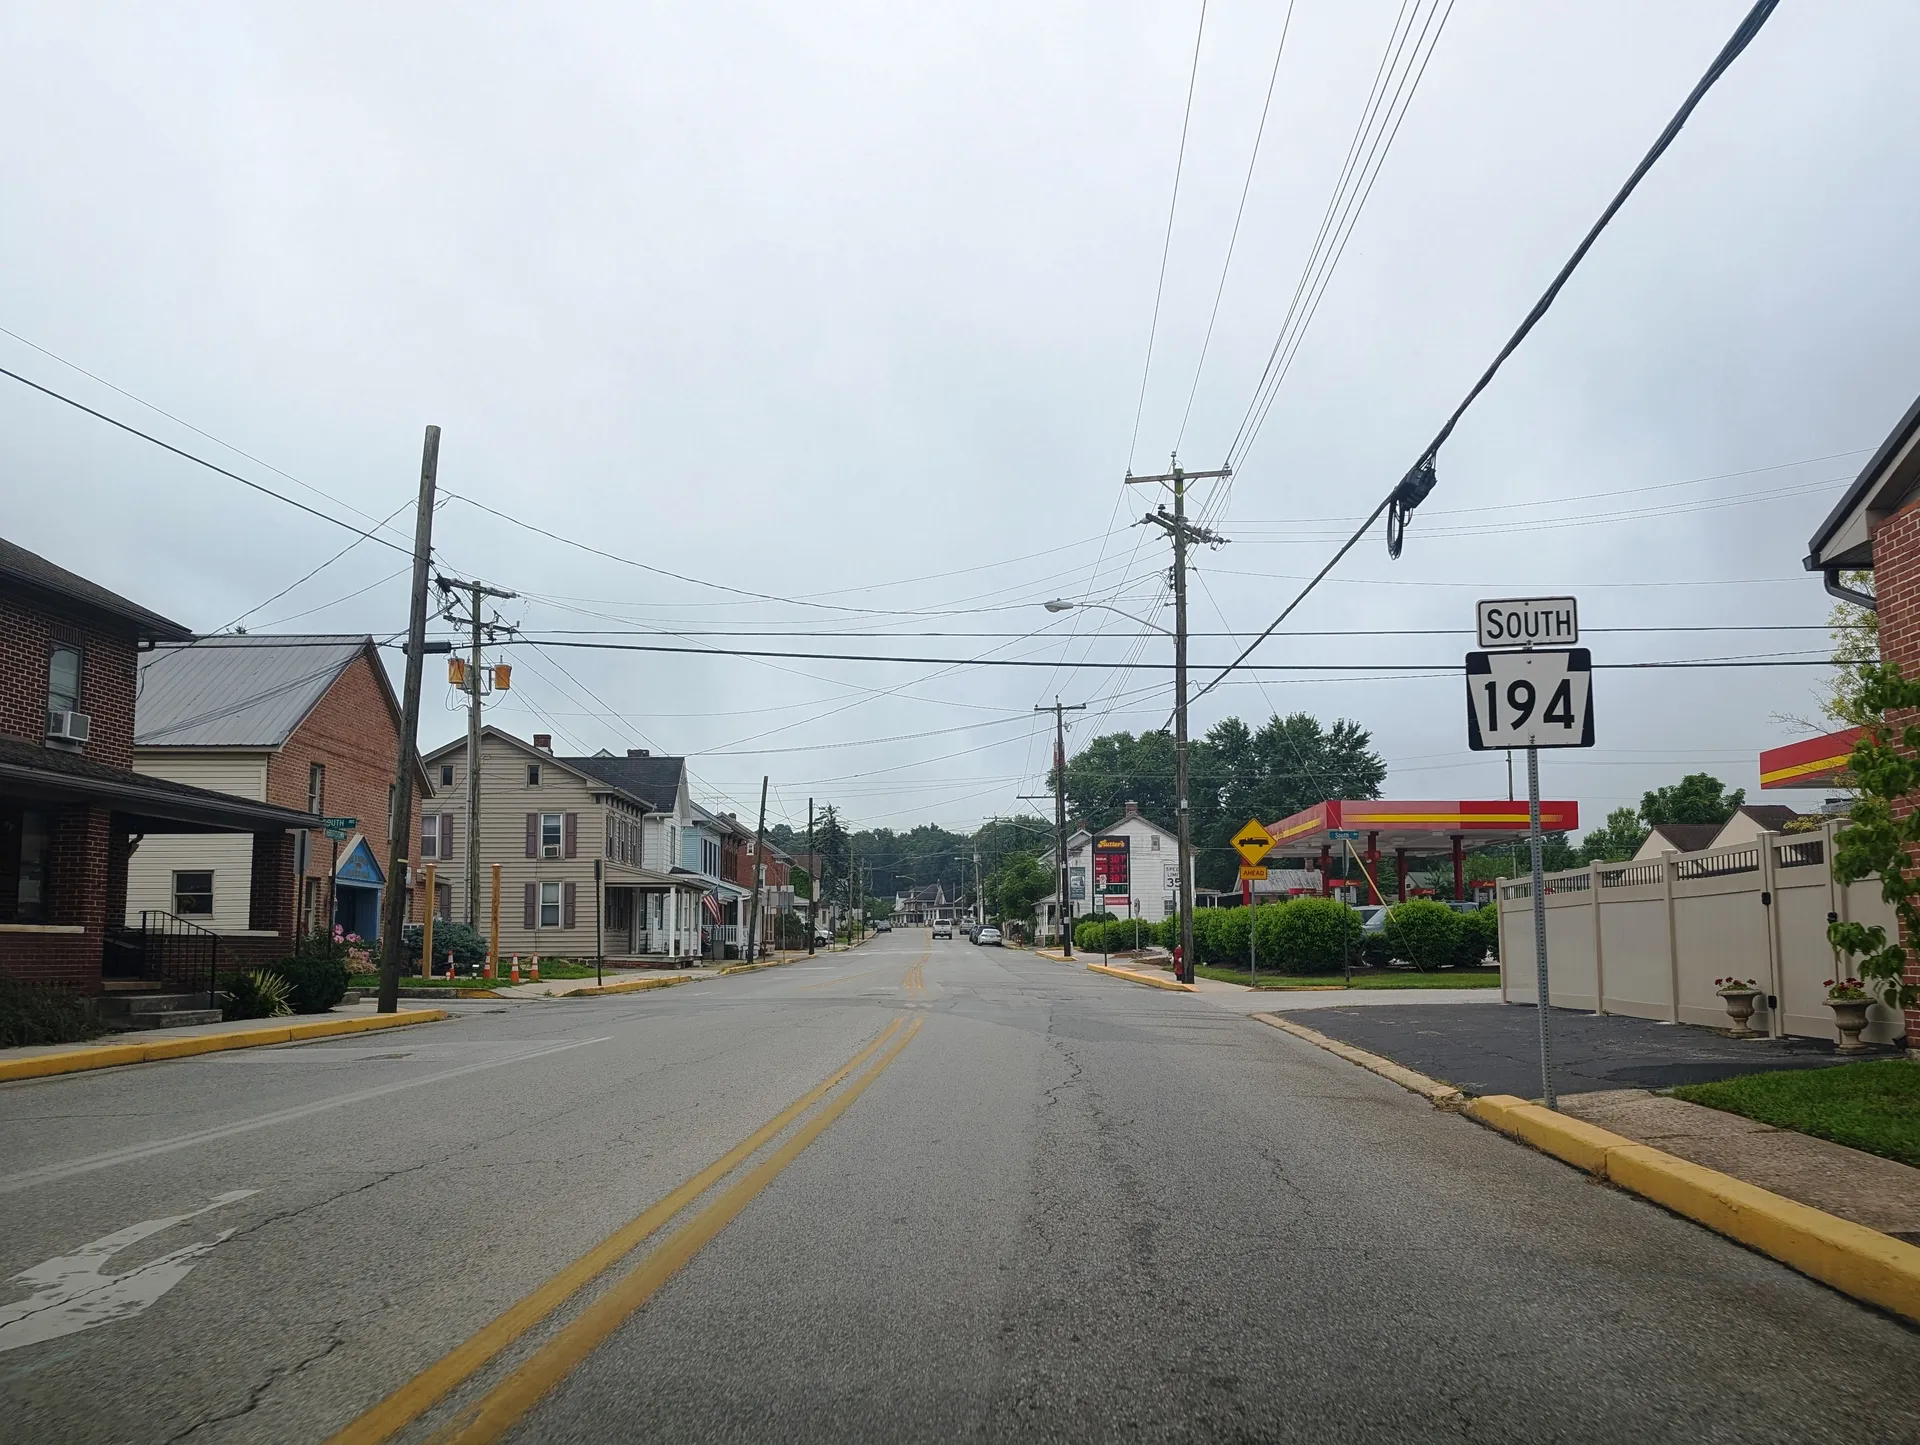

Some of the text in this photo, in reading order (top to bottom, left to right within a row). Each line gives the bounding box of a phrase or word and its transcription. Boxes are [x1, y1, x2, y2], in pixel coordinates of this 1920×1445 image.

[1486, 608, 1571, 639] SOUTH
[1484, 678, 1575, 732] 194
[1166, 877, 1183, 888] 35
